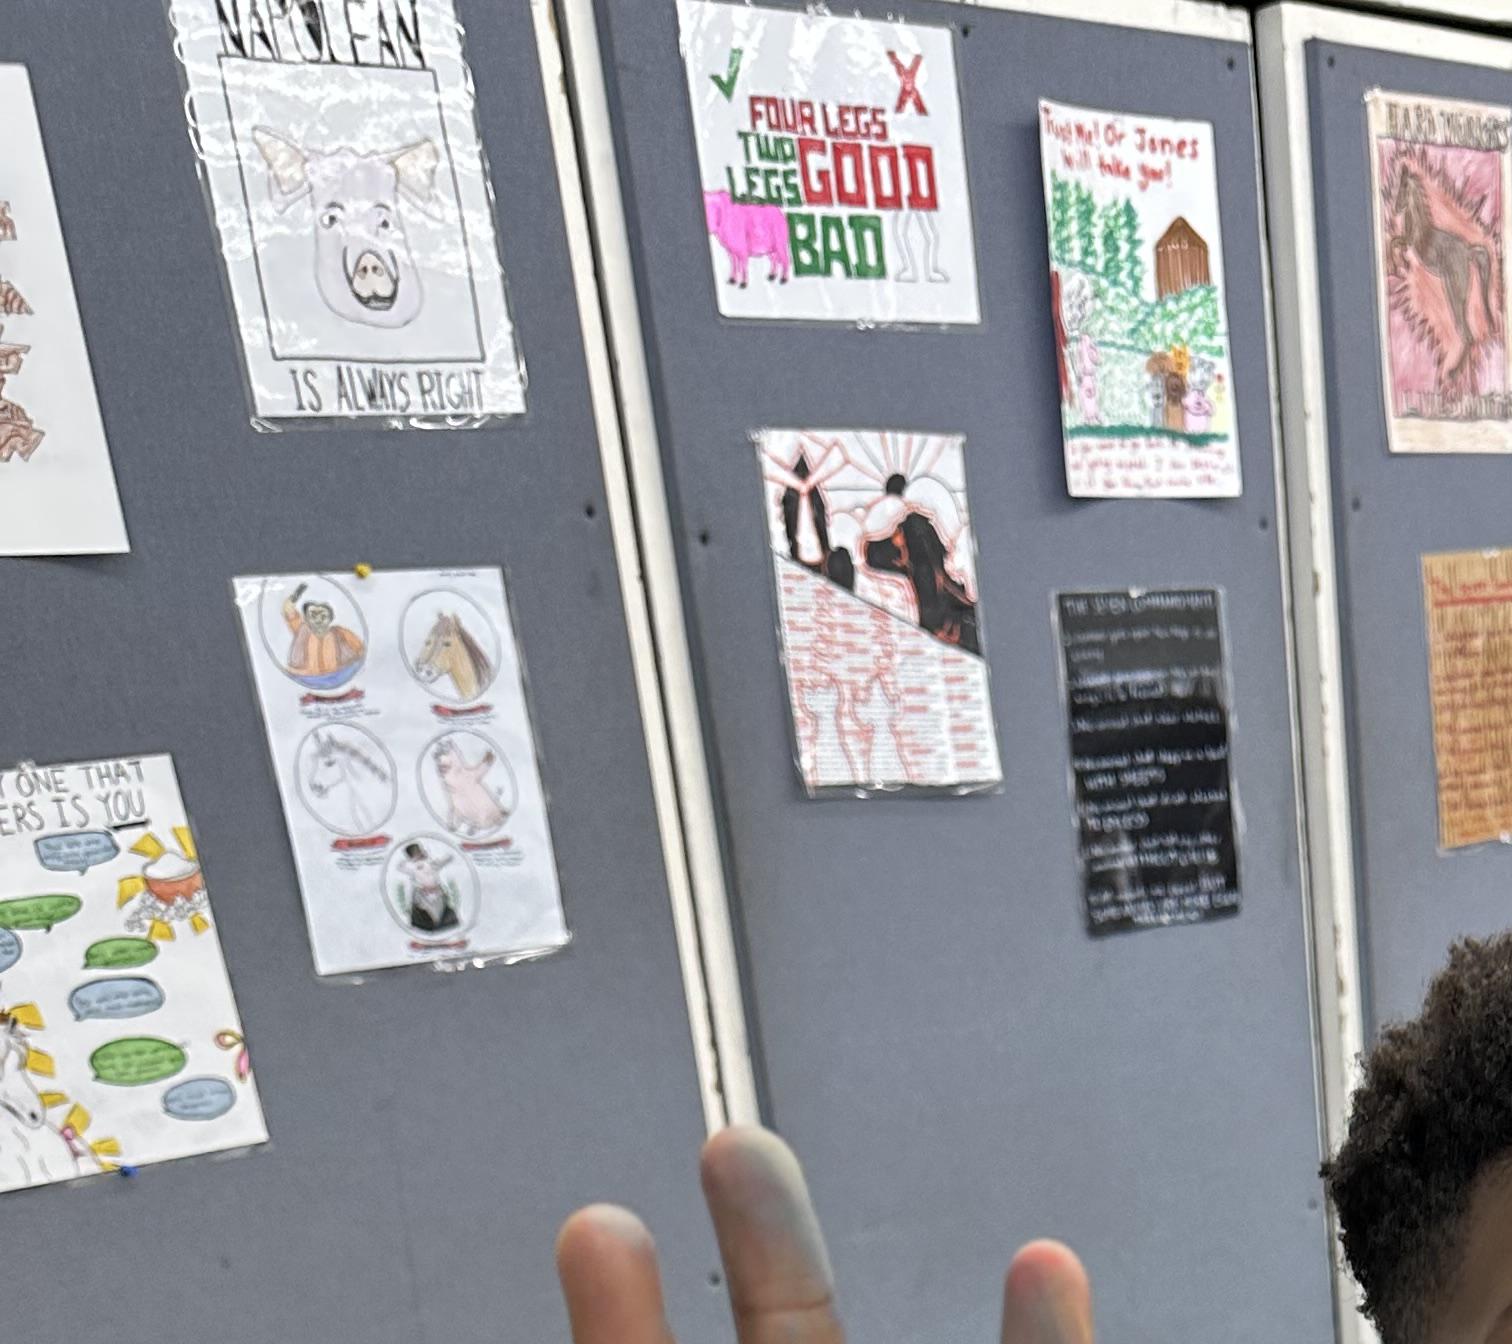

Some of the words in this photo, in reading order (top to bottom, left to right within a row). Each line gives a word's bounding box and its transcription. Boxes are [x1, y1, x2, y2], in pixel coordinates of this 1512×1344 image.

[749, 95, 818, 136] FOUR
[820, 102, 889, 142] LEGS
[737, 129, 797, 165] TWO
[725, 166, 804, 208] LEGS
[797, 136, 940, 213] GOOD
[785, 211, 888, 280] BAD
[288, 367, 323, 413] IS
[335, 364, 412, 413] ALWAYS
[415, 367, 486, 412] RIGHT
[14, 768, 71, 799] ONE
[78, 760, 145, 791] THAT
[0, 799, 46, 837] ERS
[52, 794, 91, 829] IS
[96, 787, 147, 825] YOU
